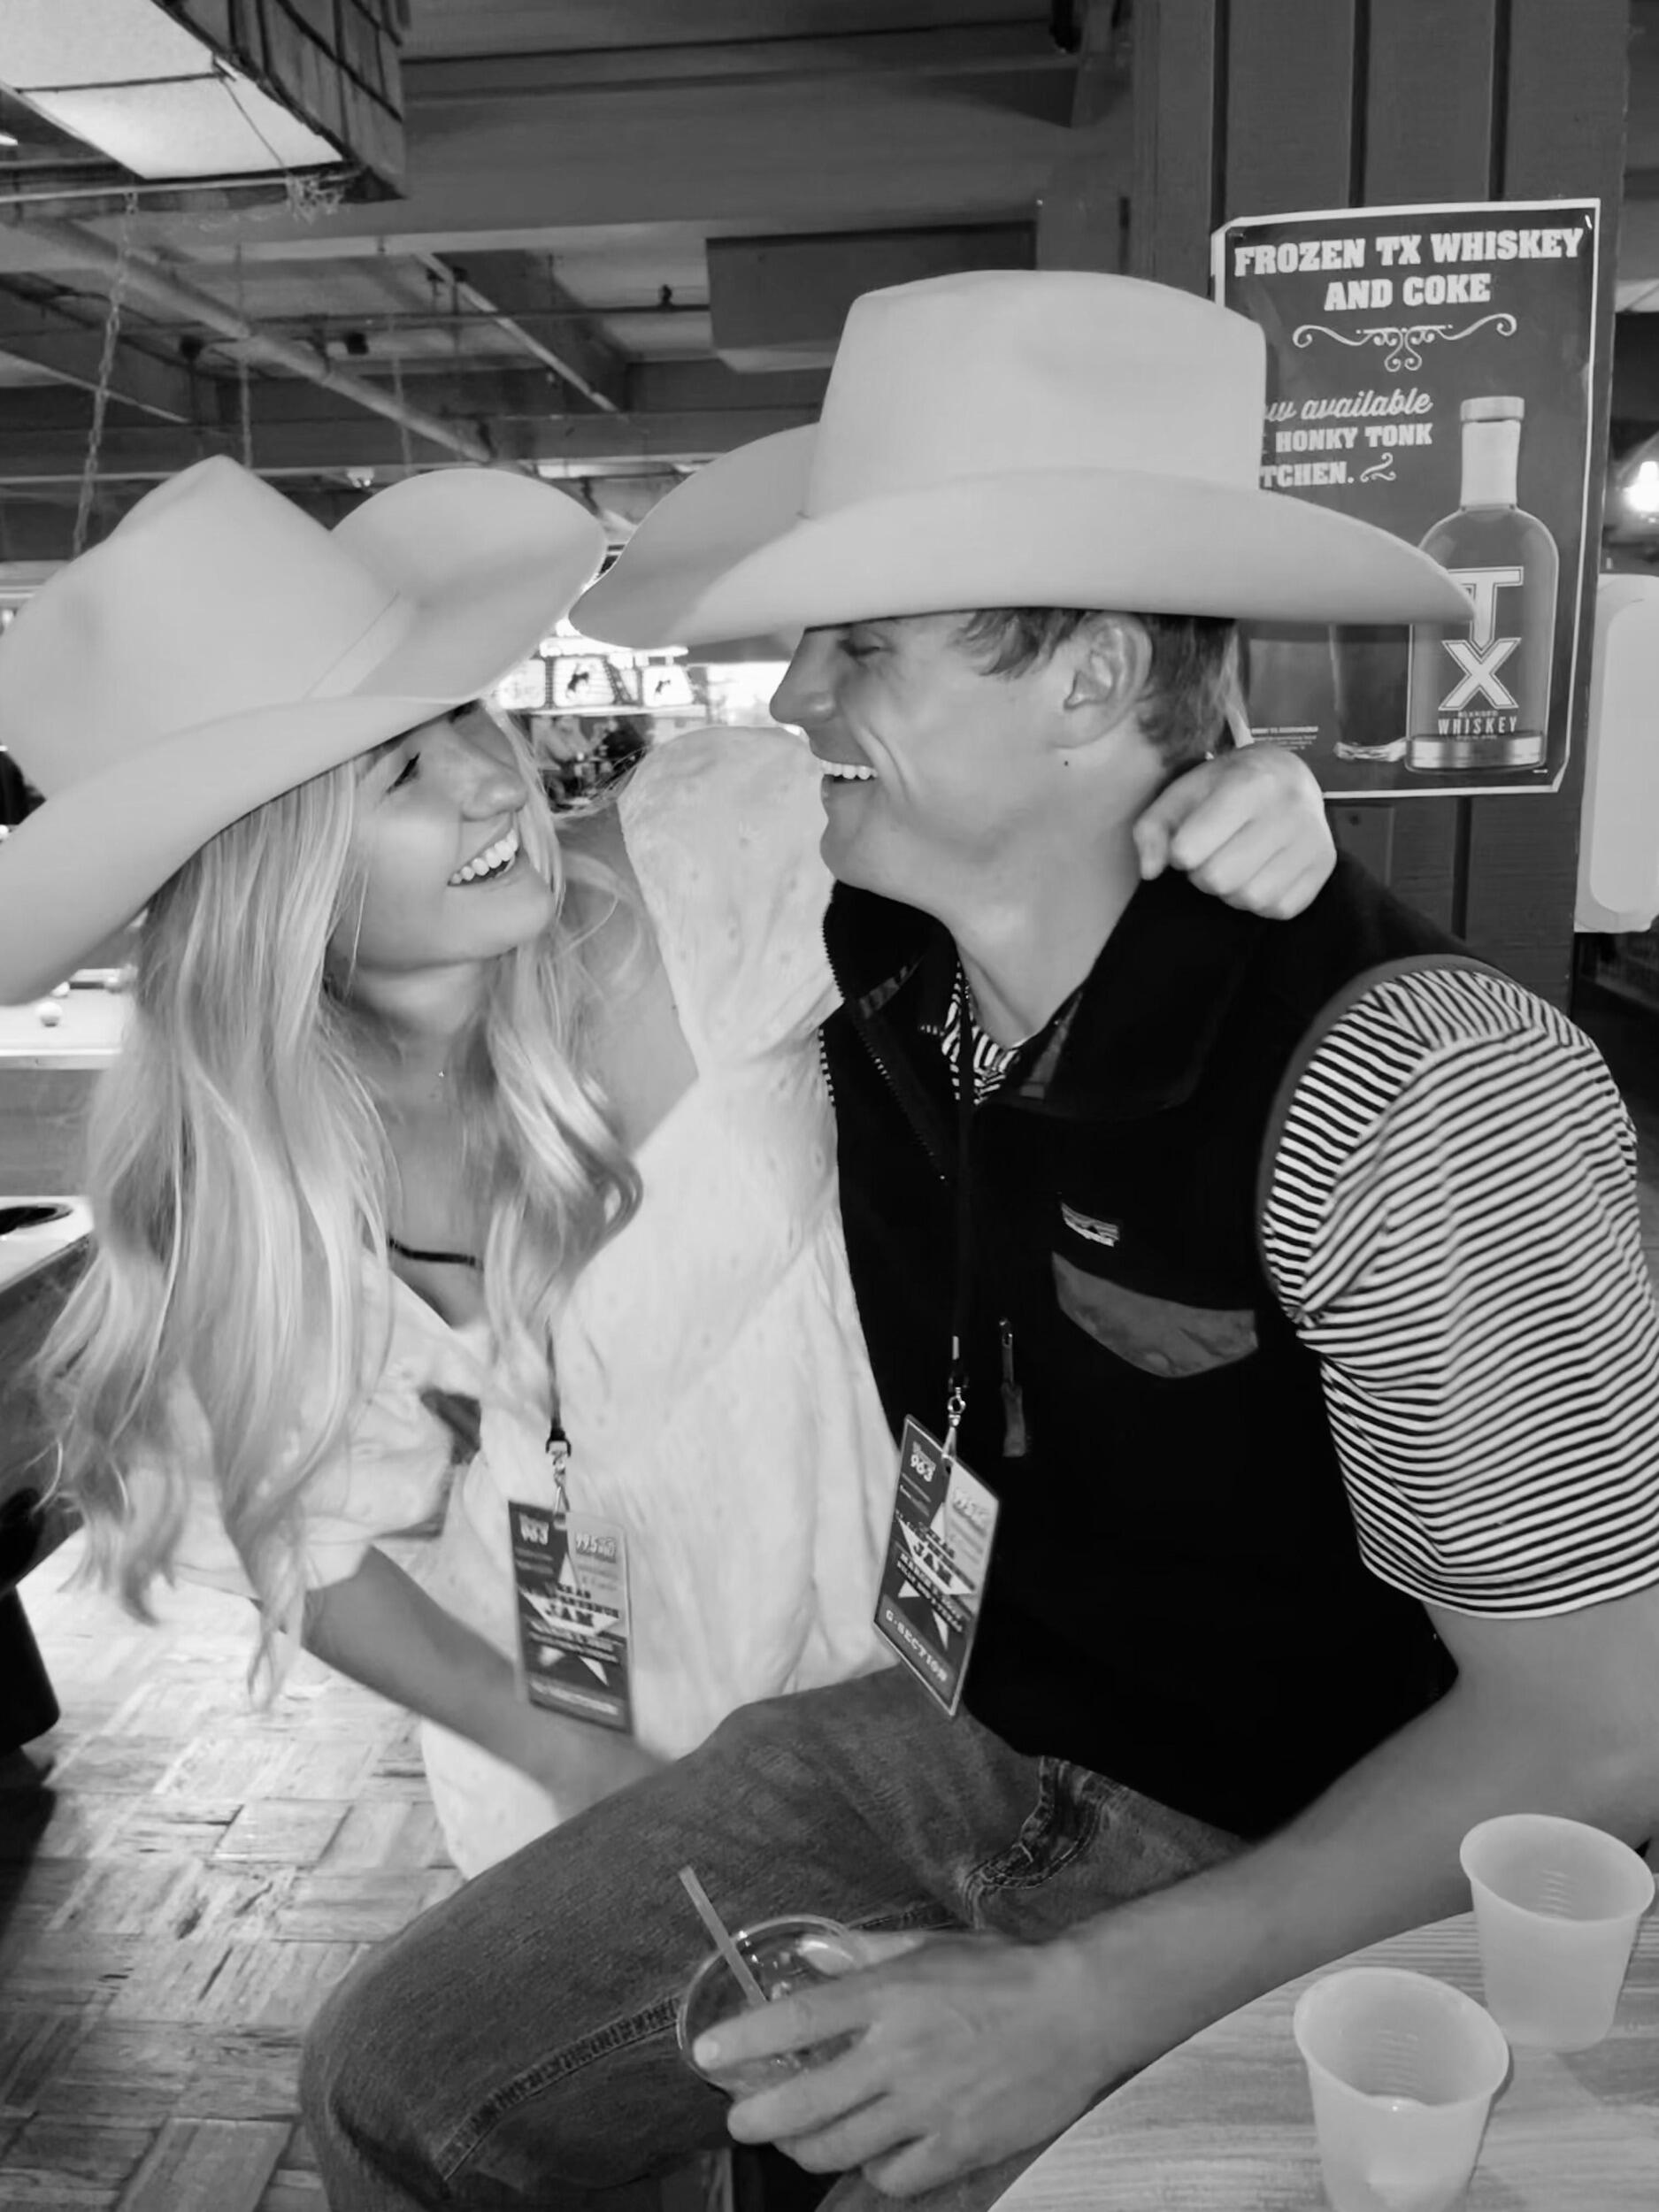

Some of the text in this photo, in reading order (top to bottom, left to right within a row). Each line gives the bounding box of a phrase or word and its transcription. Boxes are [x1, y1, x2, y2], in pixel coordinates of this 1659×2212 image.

[1234, 227, 1584, 277] FROZEN TX WHISKEY
[1324, 273, 1491, 311] AND COKE
[1301, 388, 1433, 419] available
[1275, 427, 1358, 453] HONKY
[1364, 423, 1432, 447] TONK
[1260, 462, 1354, 487] TCHEN.
[1438, 716, 1517, 734] WHISKEY
